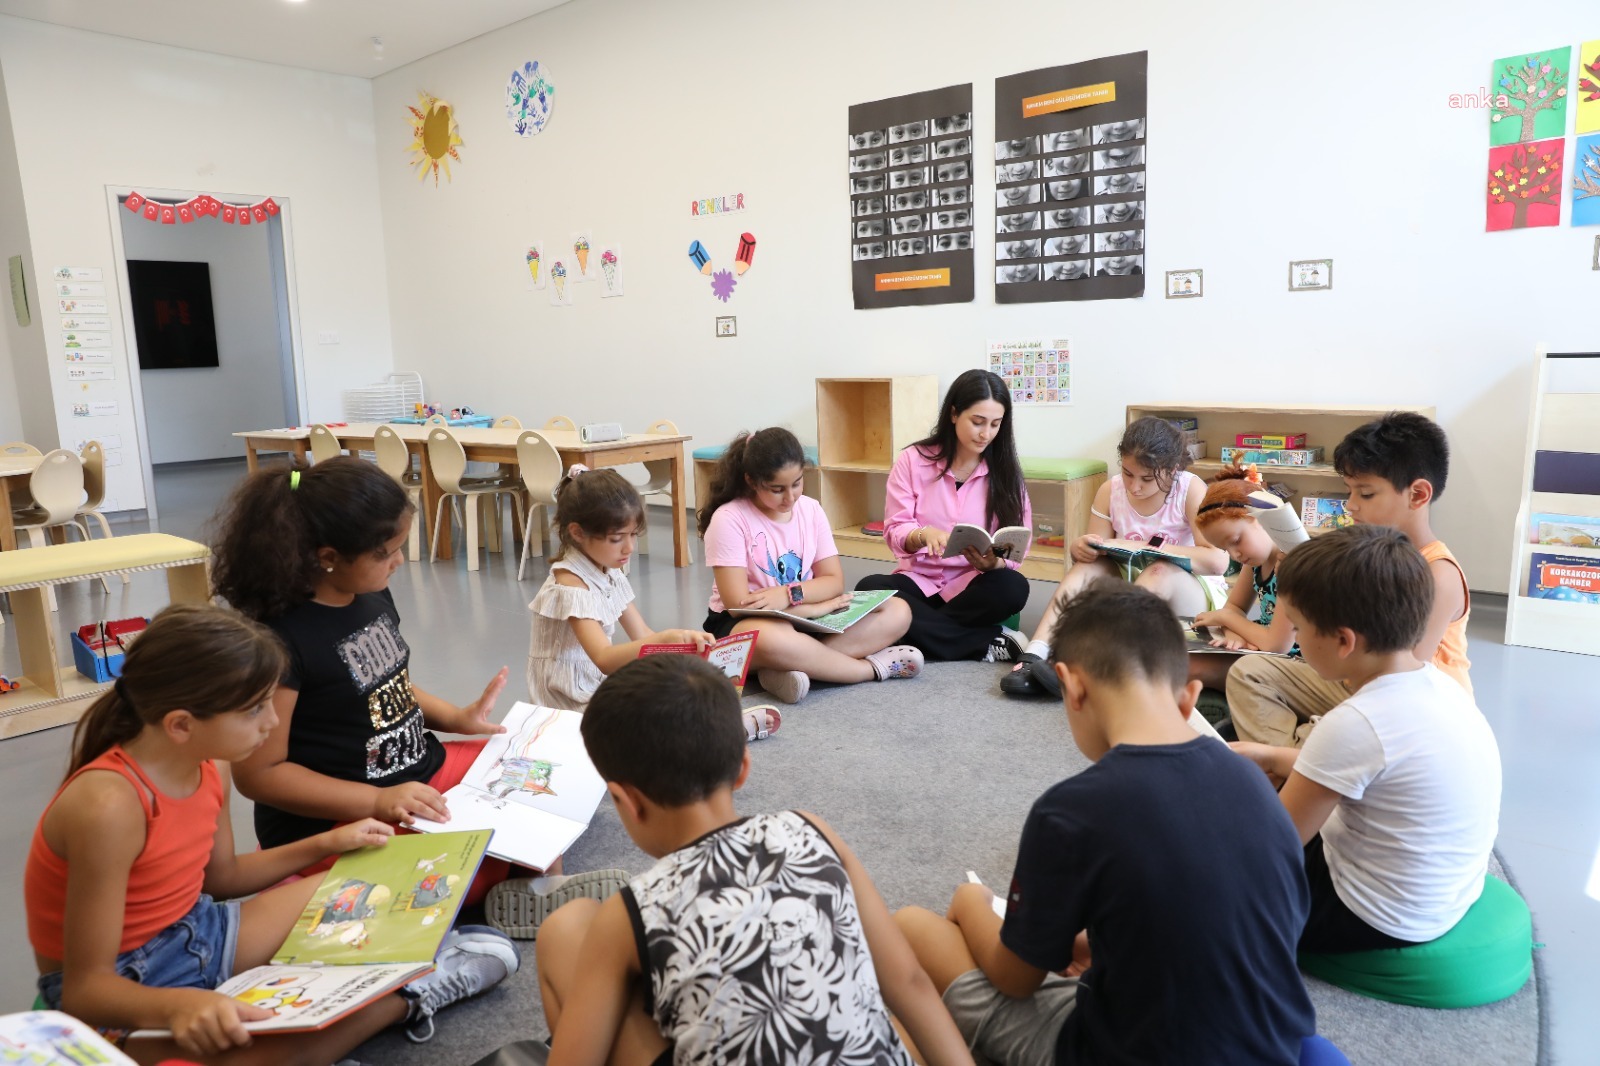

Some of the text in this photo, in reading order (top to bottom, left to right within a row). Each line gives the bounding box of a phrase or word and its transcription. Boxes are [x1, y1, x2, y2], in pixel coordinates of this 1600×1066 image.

[692, 193, 745, 216] RENKLER
[1559, 578, 1591, 588] KAMBER
[343, 623, 406, 684] COOL
